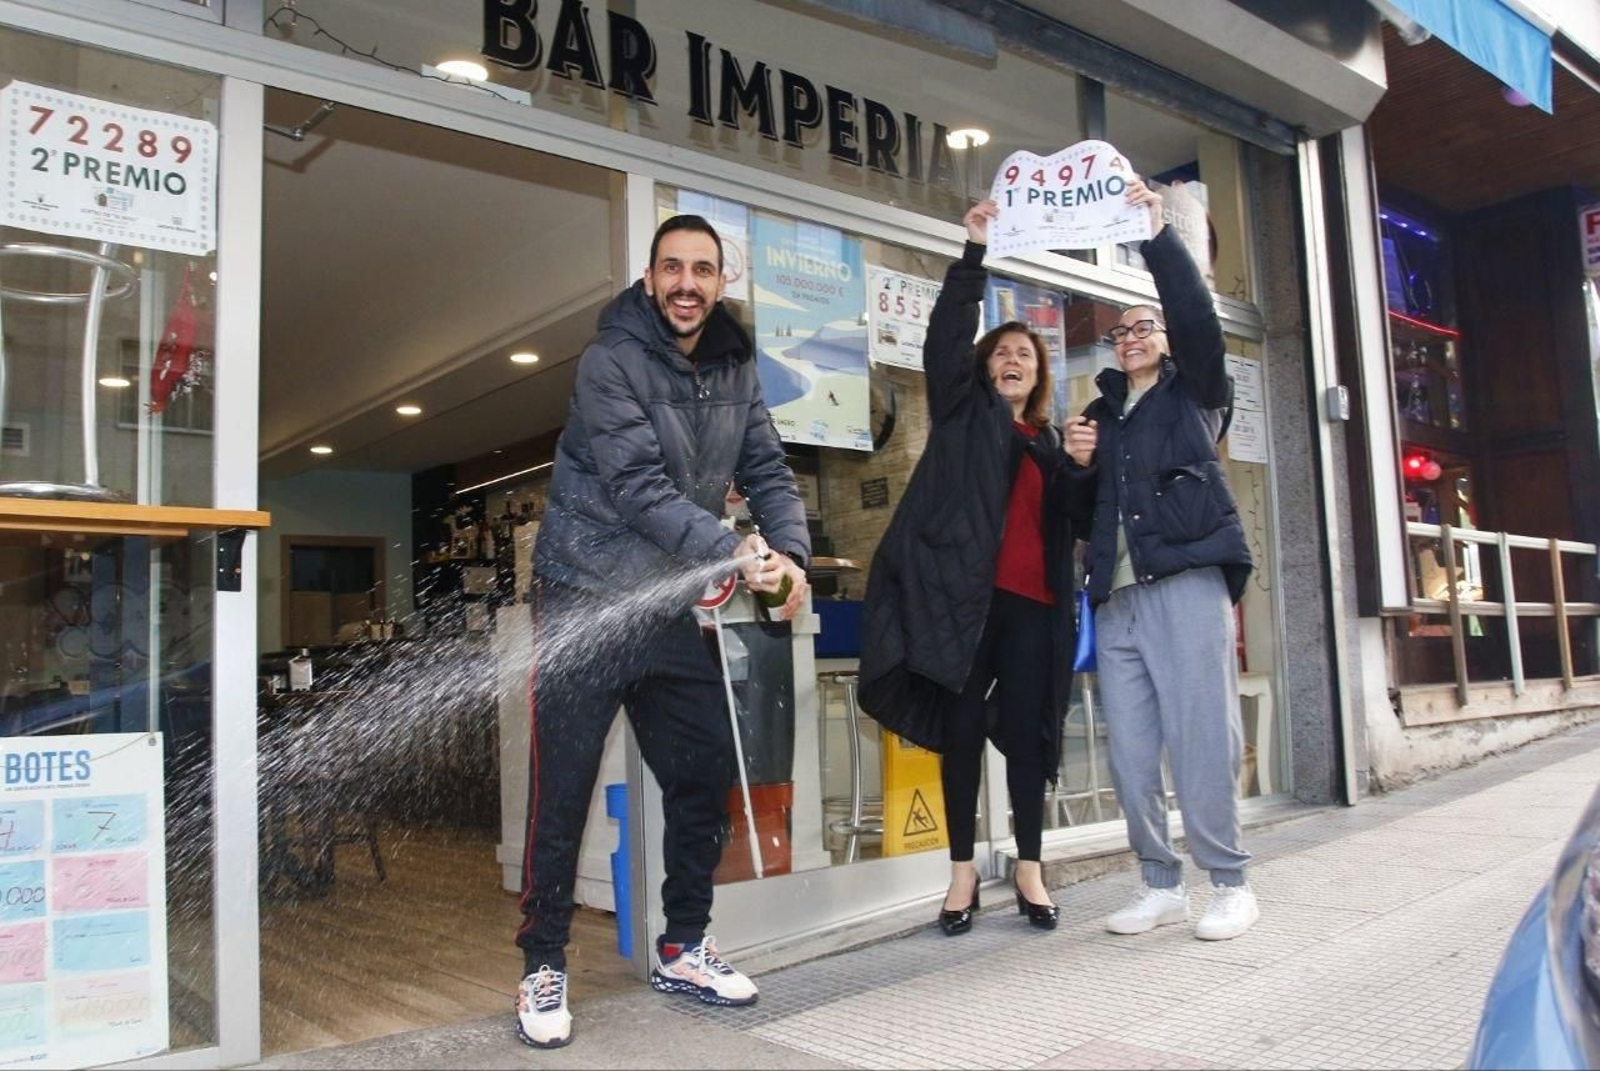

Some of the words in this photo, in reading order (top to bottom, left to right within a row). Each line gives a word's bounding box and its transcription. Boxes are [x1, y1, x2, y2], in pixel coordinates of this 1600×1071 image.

[482, 0, 658, 106] BAR
[63, 151, 187, 195] PREMIO
[1027, 175, 1126, 208] PREMIO
[766, 245, 852, 282] INVIERNO
[5, 750, 91, 784] BOTES
[87, 811, 117, 841] 7
